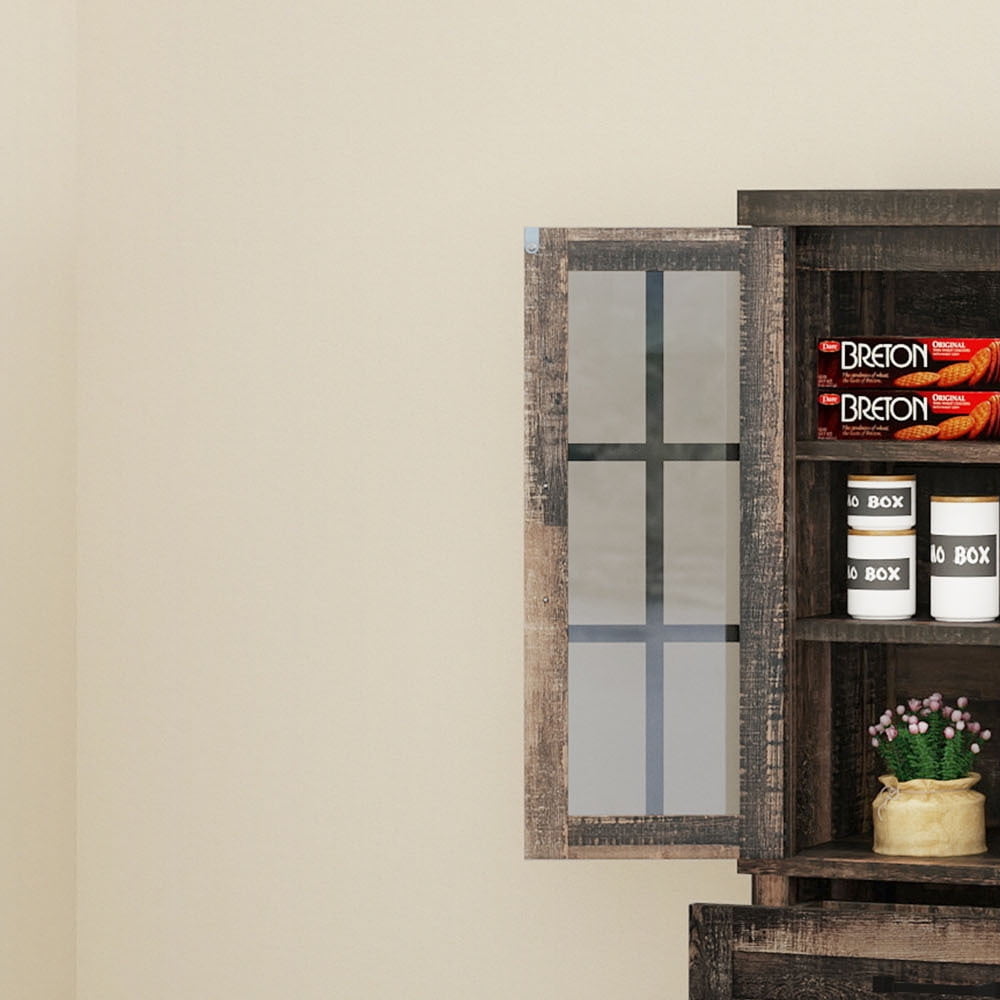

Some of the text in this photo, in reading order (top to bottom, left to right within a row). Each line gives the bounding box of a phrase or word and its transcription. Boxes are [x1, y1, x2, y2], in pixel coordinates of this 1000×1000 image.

[932, 340, 966, 348] ORIGINAL
[841, 341, 928, 370] BRETON
[932, 393, 966, 401] ORIGINAL
[841, 394, 928, 423] BRETON
[867, 495, 904, 509] BOX
[954, 545, 990, 565] BOX
[864, 566, 901, 581] BOX
